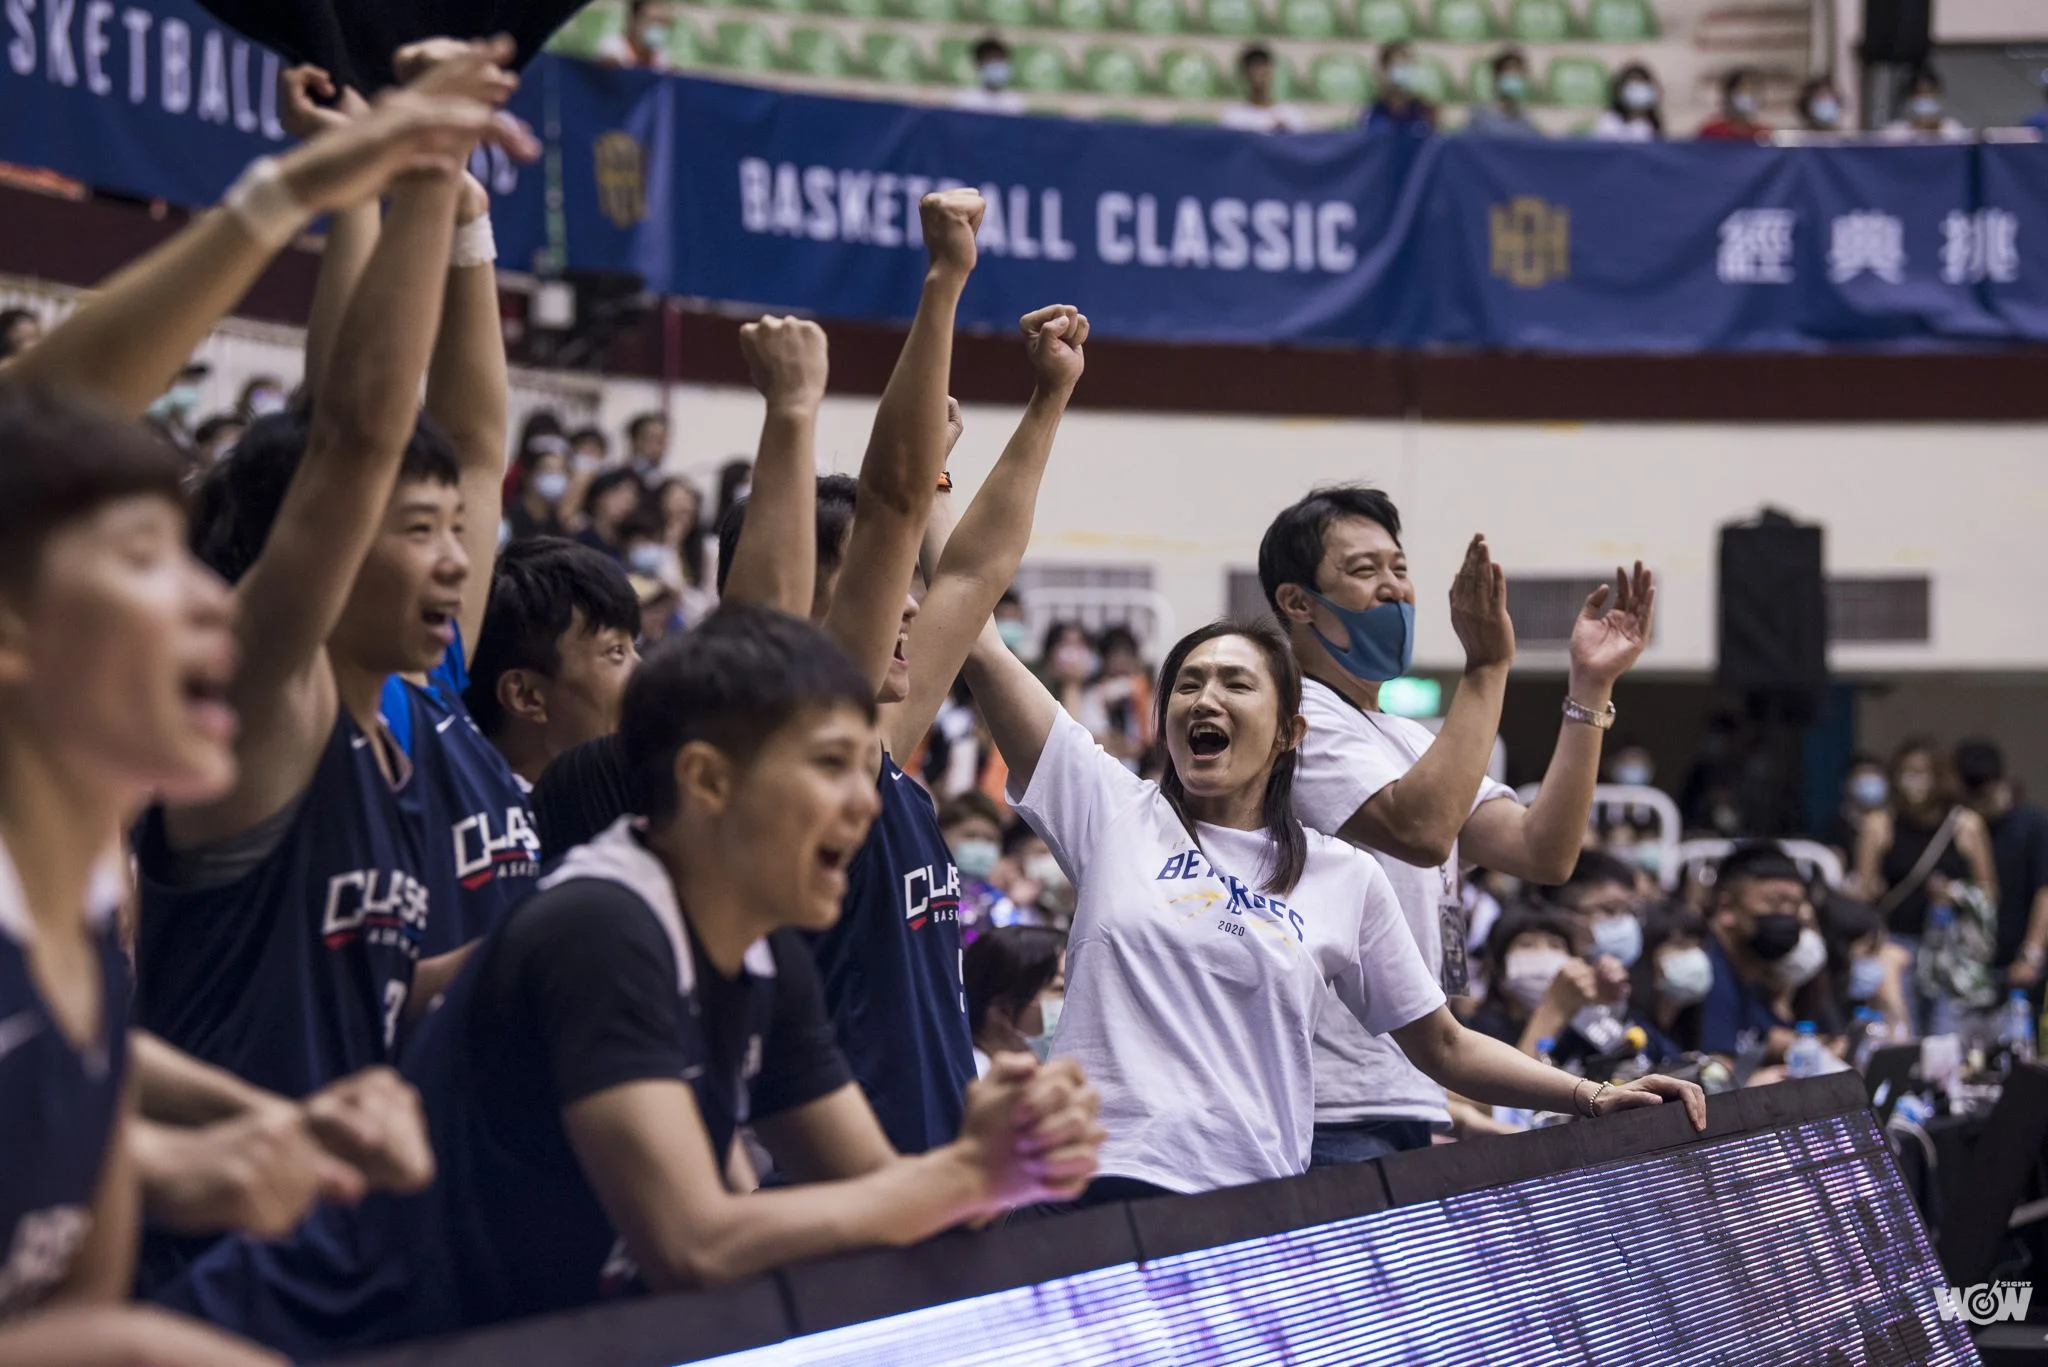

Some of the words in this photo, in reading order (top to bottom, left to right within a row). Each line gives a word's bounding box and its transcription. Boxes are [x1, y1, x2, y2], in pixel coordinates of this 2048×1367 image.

[738, 157, 1077, 261] BASKETALL
[1096, 191, 1358, 273] CLASSIC
[1217, 920, 1245, 937] 2020
